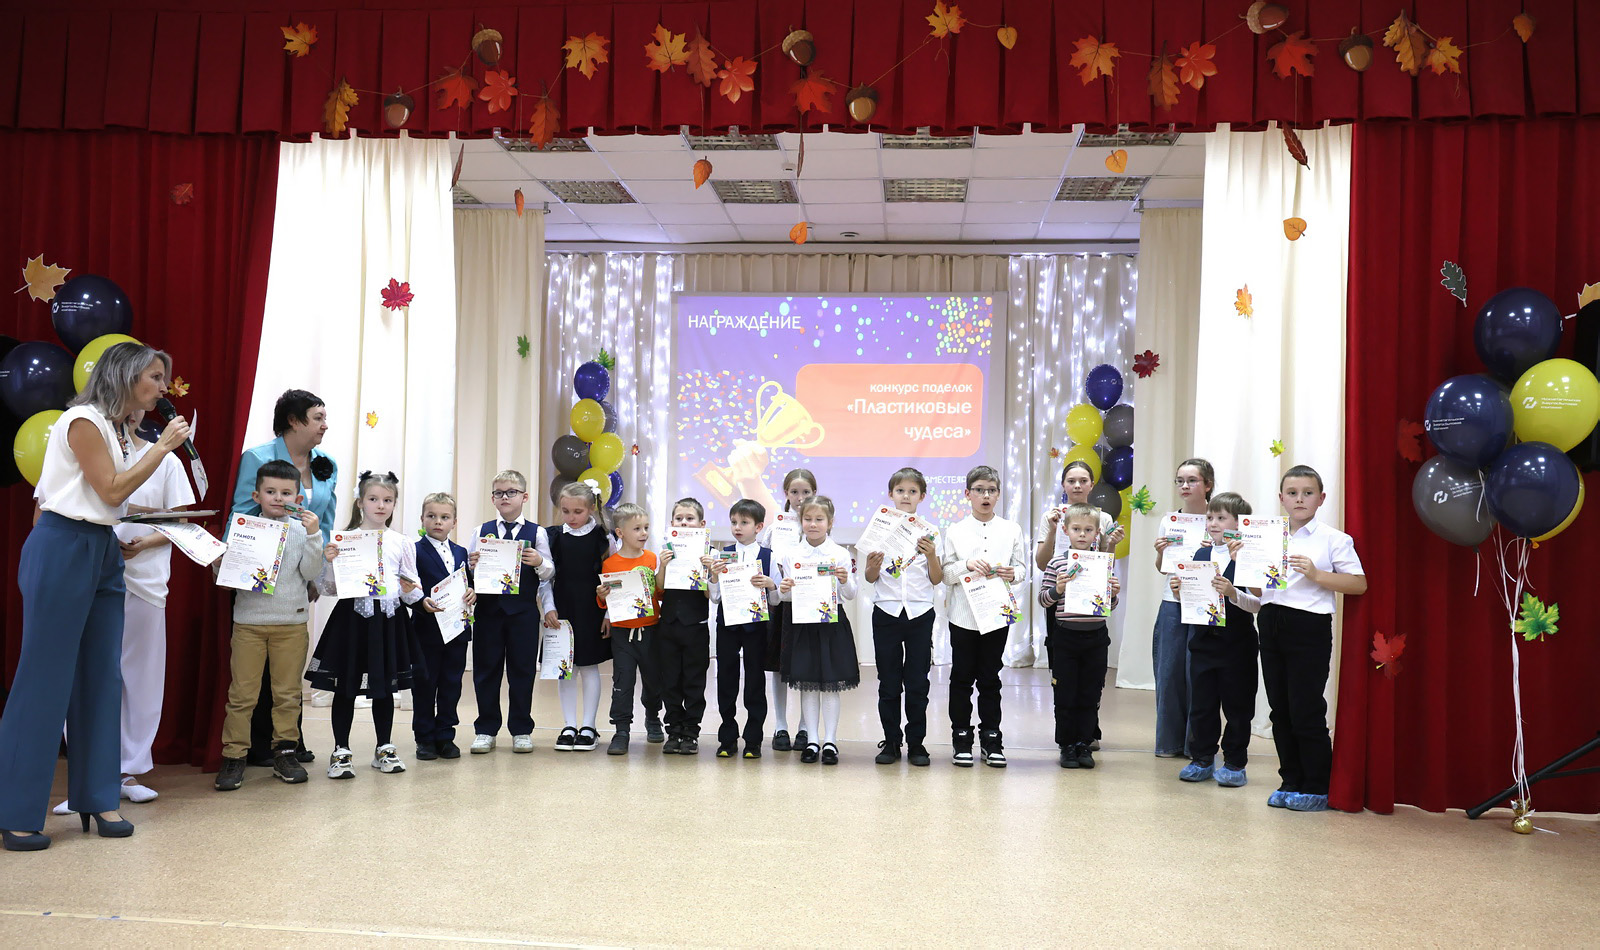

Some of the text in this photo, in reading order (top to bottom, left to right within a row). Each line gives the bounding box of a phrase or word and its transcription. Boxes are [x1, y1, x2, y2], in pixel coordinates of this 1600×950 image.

[688, 315, 801, 330] НАГРАЖДЕНИЕ
[870, 382, 973, 395] конкурс поделок
[847, 398, 972, 414] «Пластиковые
[904, 426, 972, 441] чудеса»
[233, 533, 256, 541] ГРАМОТА
